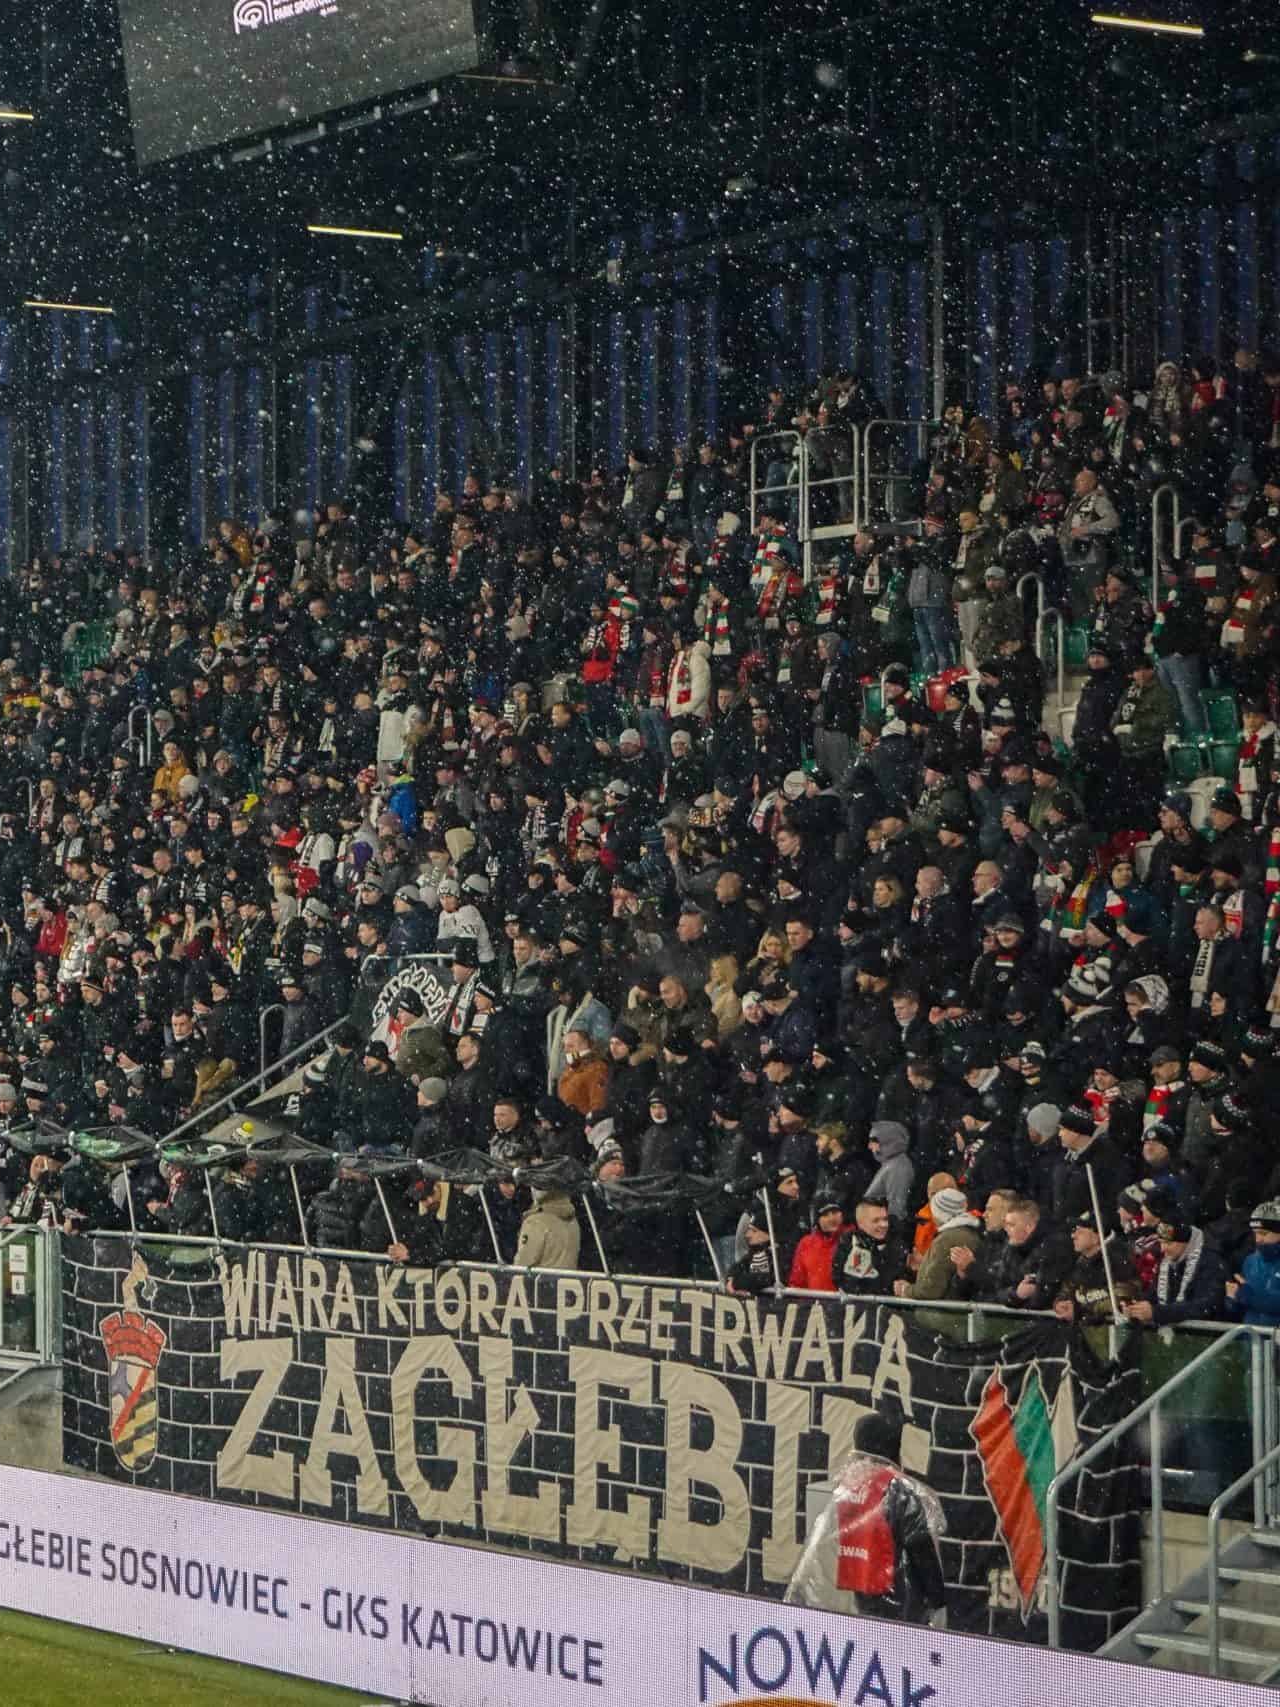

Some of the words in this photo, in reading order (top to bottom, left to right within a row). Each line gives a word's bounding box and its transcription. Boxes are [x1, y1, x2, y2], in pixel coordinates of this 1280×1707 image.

[216, 1249, 361, 1336] WIARA
[556, 1277, 915, 1417] PRZETRWAŁA
[101, 1542, 288, 1619] SOSNOWIEC
[323, 1586, 389, 1639] GKS
[401, 1603, 603, 1686] KATOWICE
[699, 1626, 937, 1707] NOWAK
